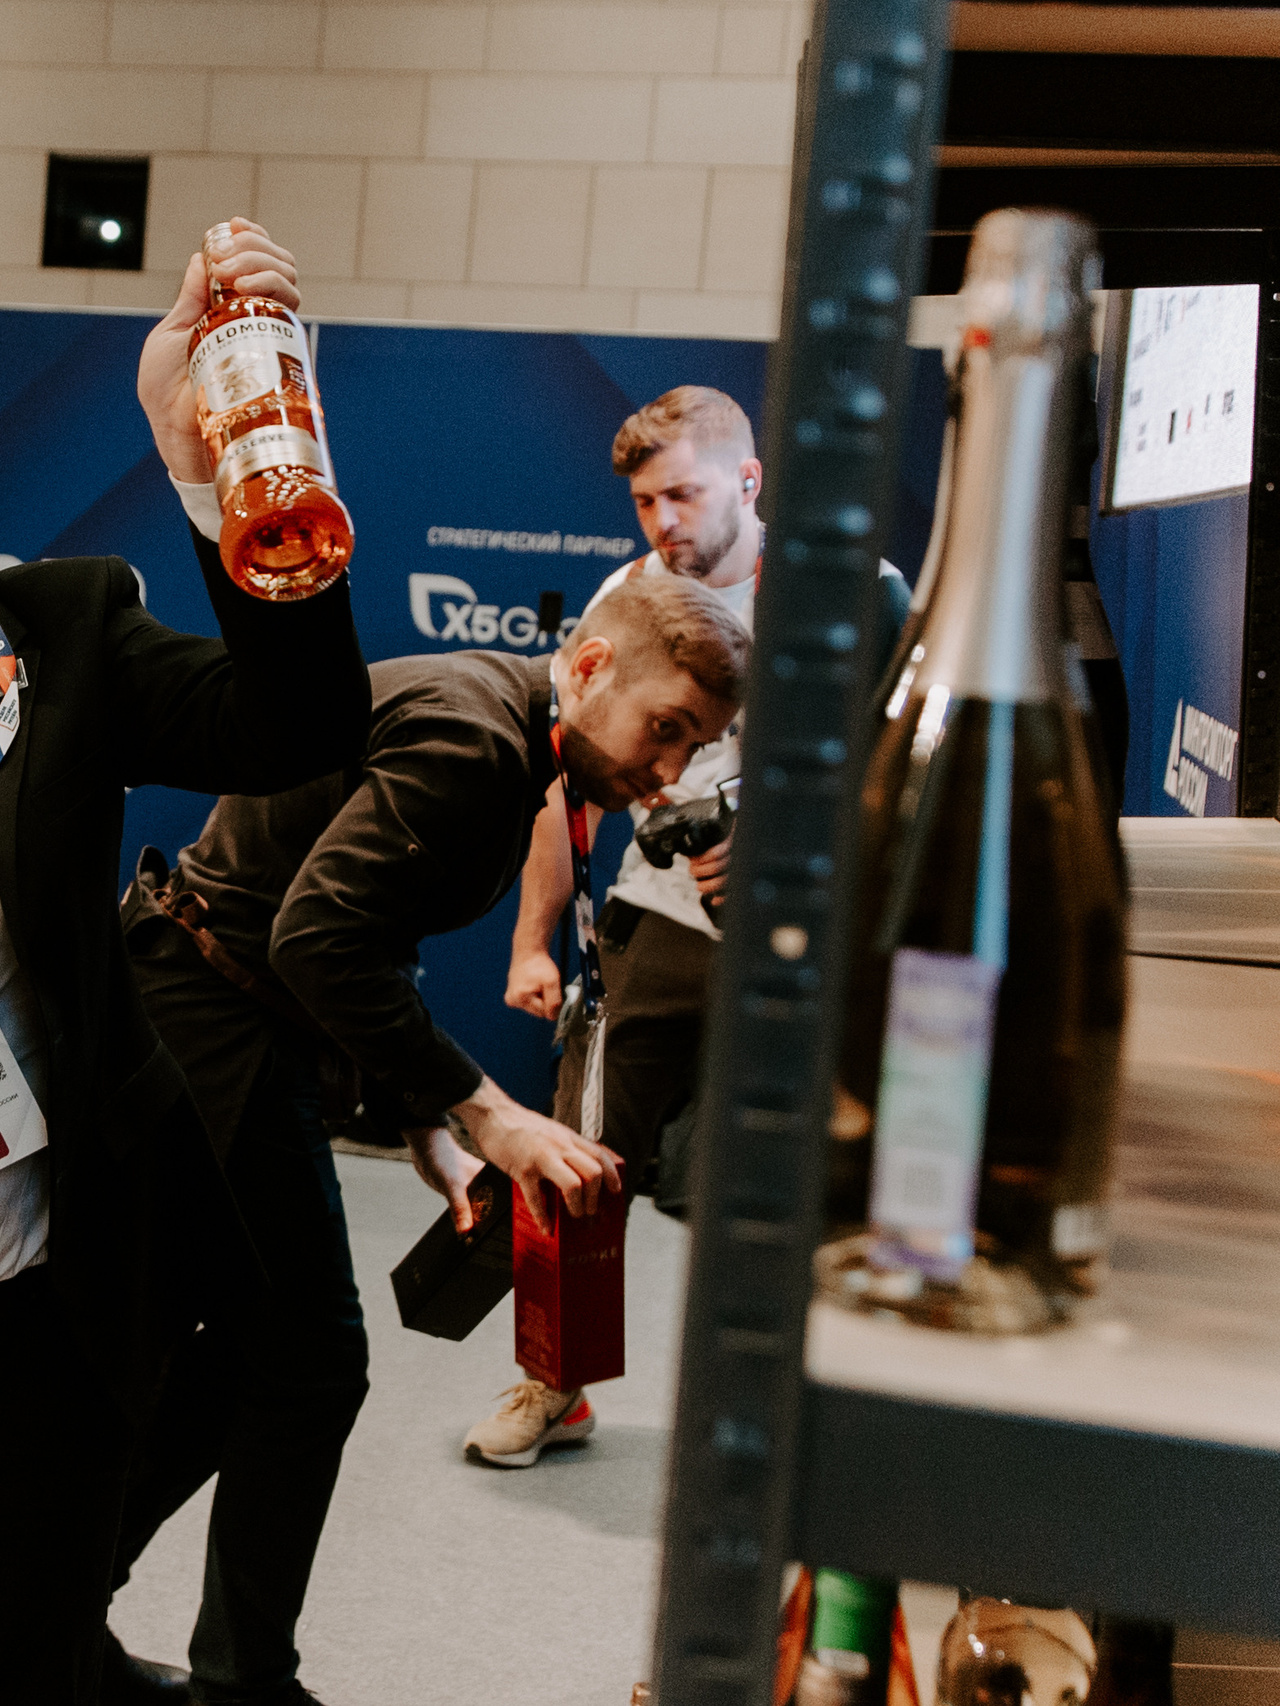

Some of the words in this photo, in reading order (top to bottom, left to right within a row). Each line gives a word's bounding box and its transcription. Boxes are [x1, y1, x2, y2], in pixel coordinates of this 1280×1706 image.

[215, 321, 294, 344] LOMOND
[426, 525, 562, 554] СТРАТЕГИЧЕСКИЙ
[563, 534, 635, 558] ПАРТНЕР
